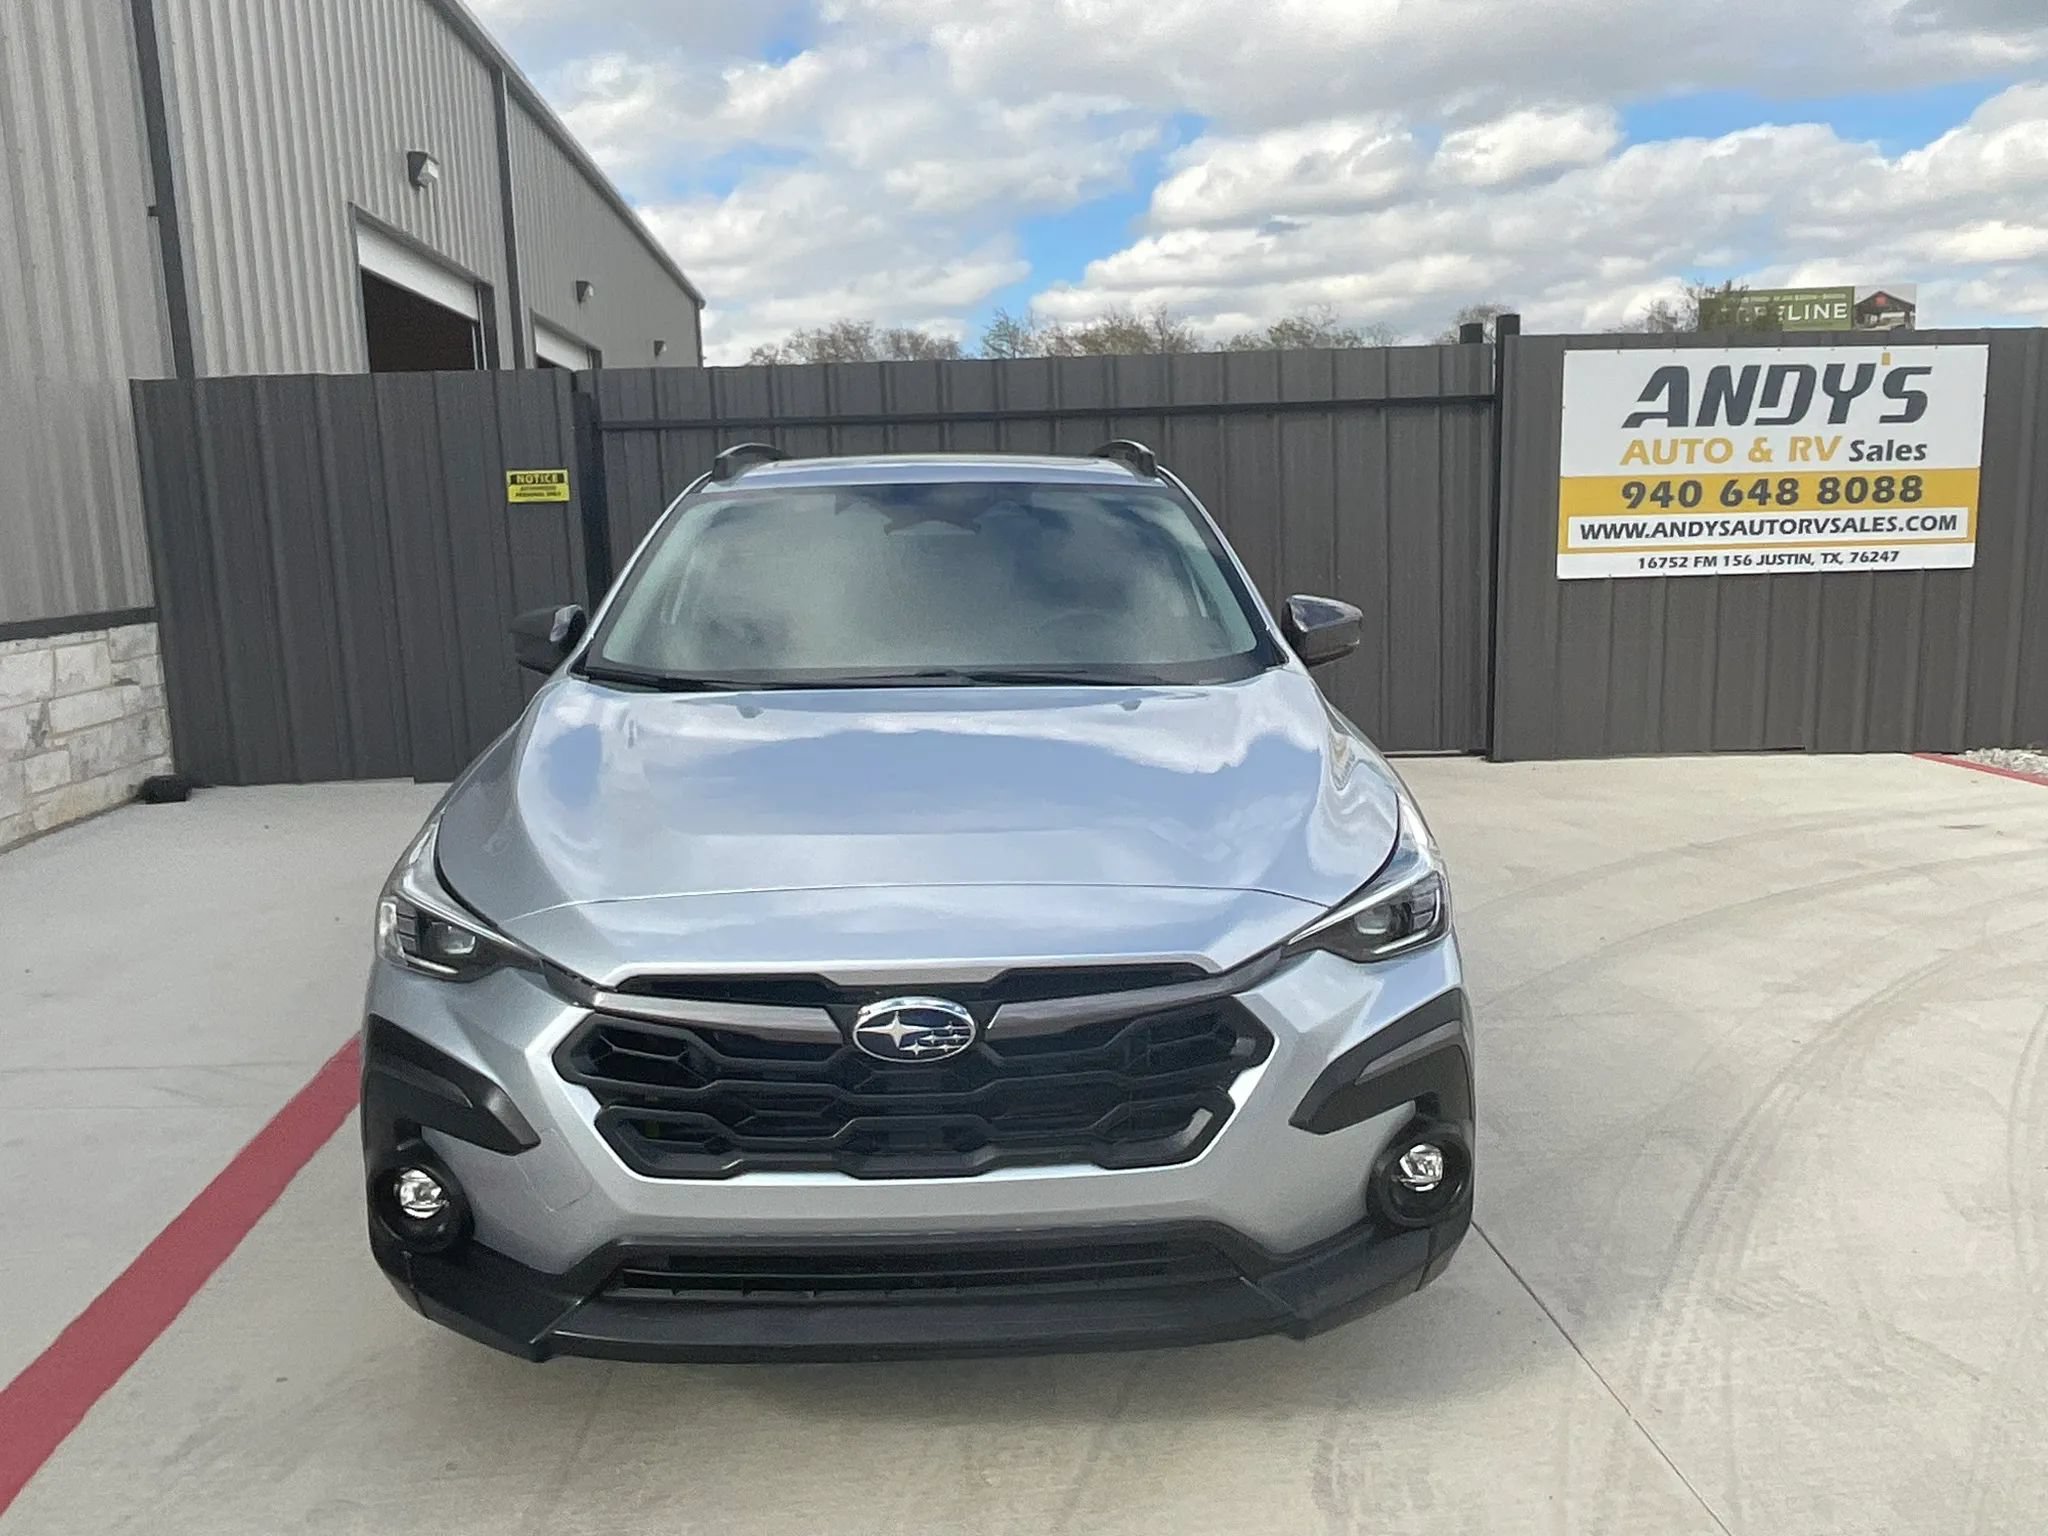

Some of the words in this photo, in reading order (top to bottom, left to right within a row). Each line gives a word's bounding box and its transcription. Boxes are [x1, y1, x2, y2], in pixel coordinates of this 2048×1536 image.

[1621, 352, 1933, 428] ANDY'S
[1619, 437, 1734, 466] AUTO
[1748, 437, 1773, 463] &
[1788, 435, 1842, 463] RV
[1849, 439, 1928, 462] Sales
[516, 473, 558, 483] NOTICE
[1622, 480, 1704, 509] 940
[1719, 477, 1799, 507] 648
[1817, 475, 1923, 505] 8088
[1580, 514, 1958, 540] WWW.ANDYSAUTORVSALES.COM
[1638, 556, 1688, 570] 16752
[1693, 556, 1718, 568] FM
[1723, 554, 1752, 567] 156
[1756, 553, 1815, 566] JUSTIN,
[1820, 552, 1844, 565] TX,
[1850, 550, 1899, 563] 76247
